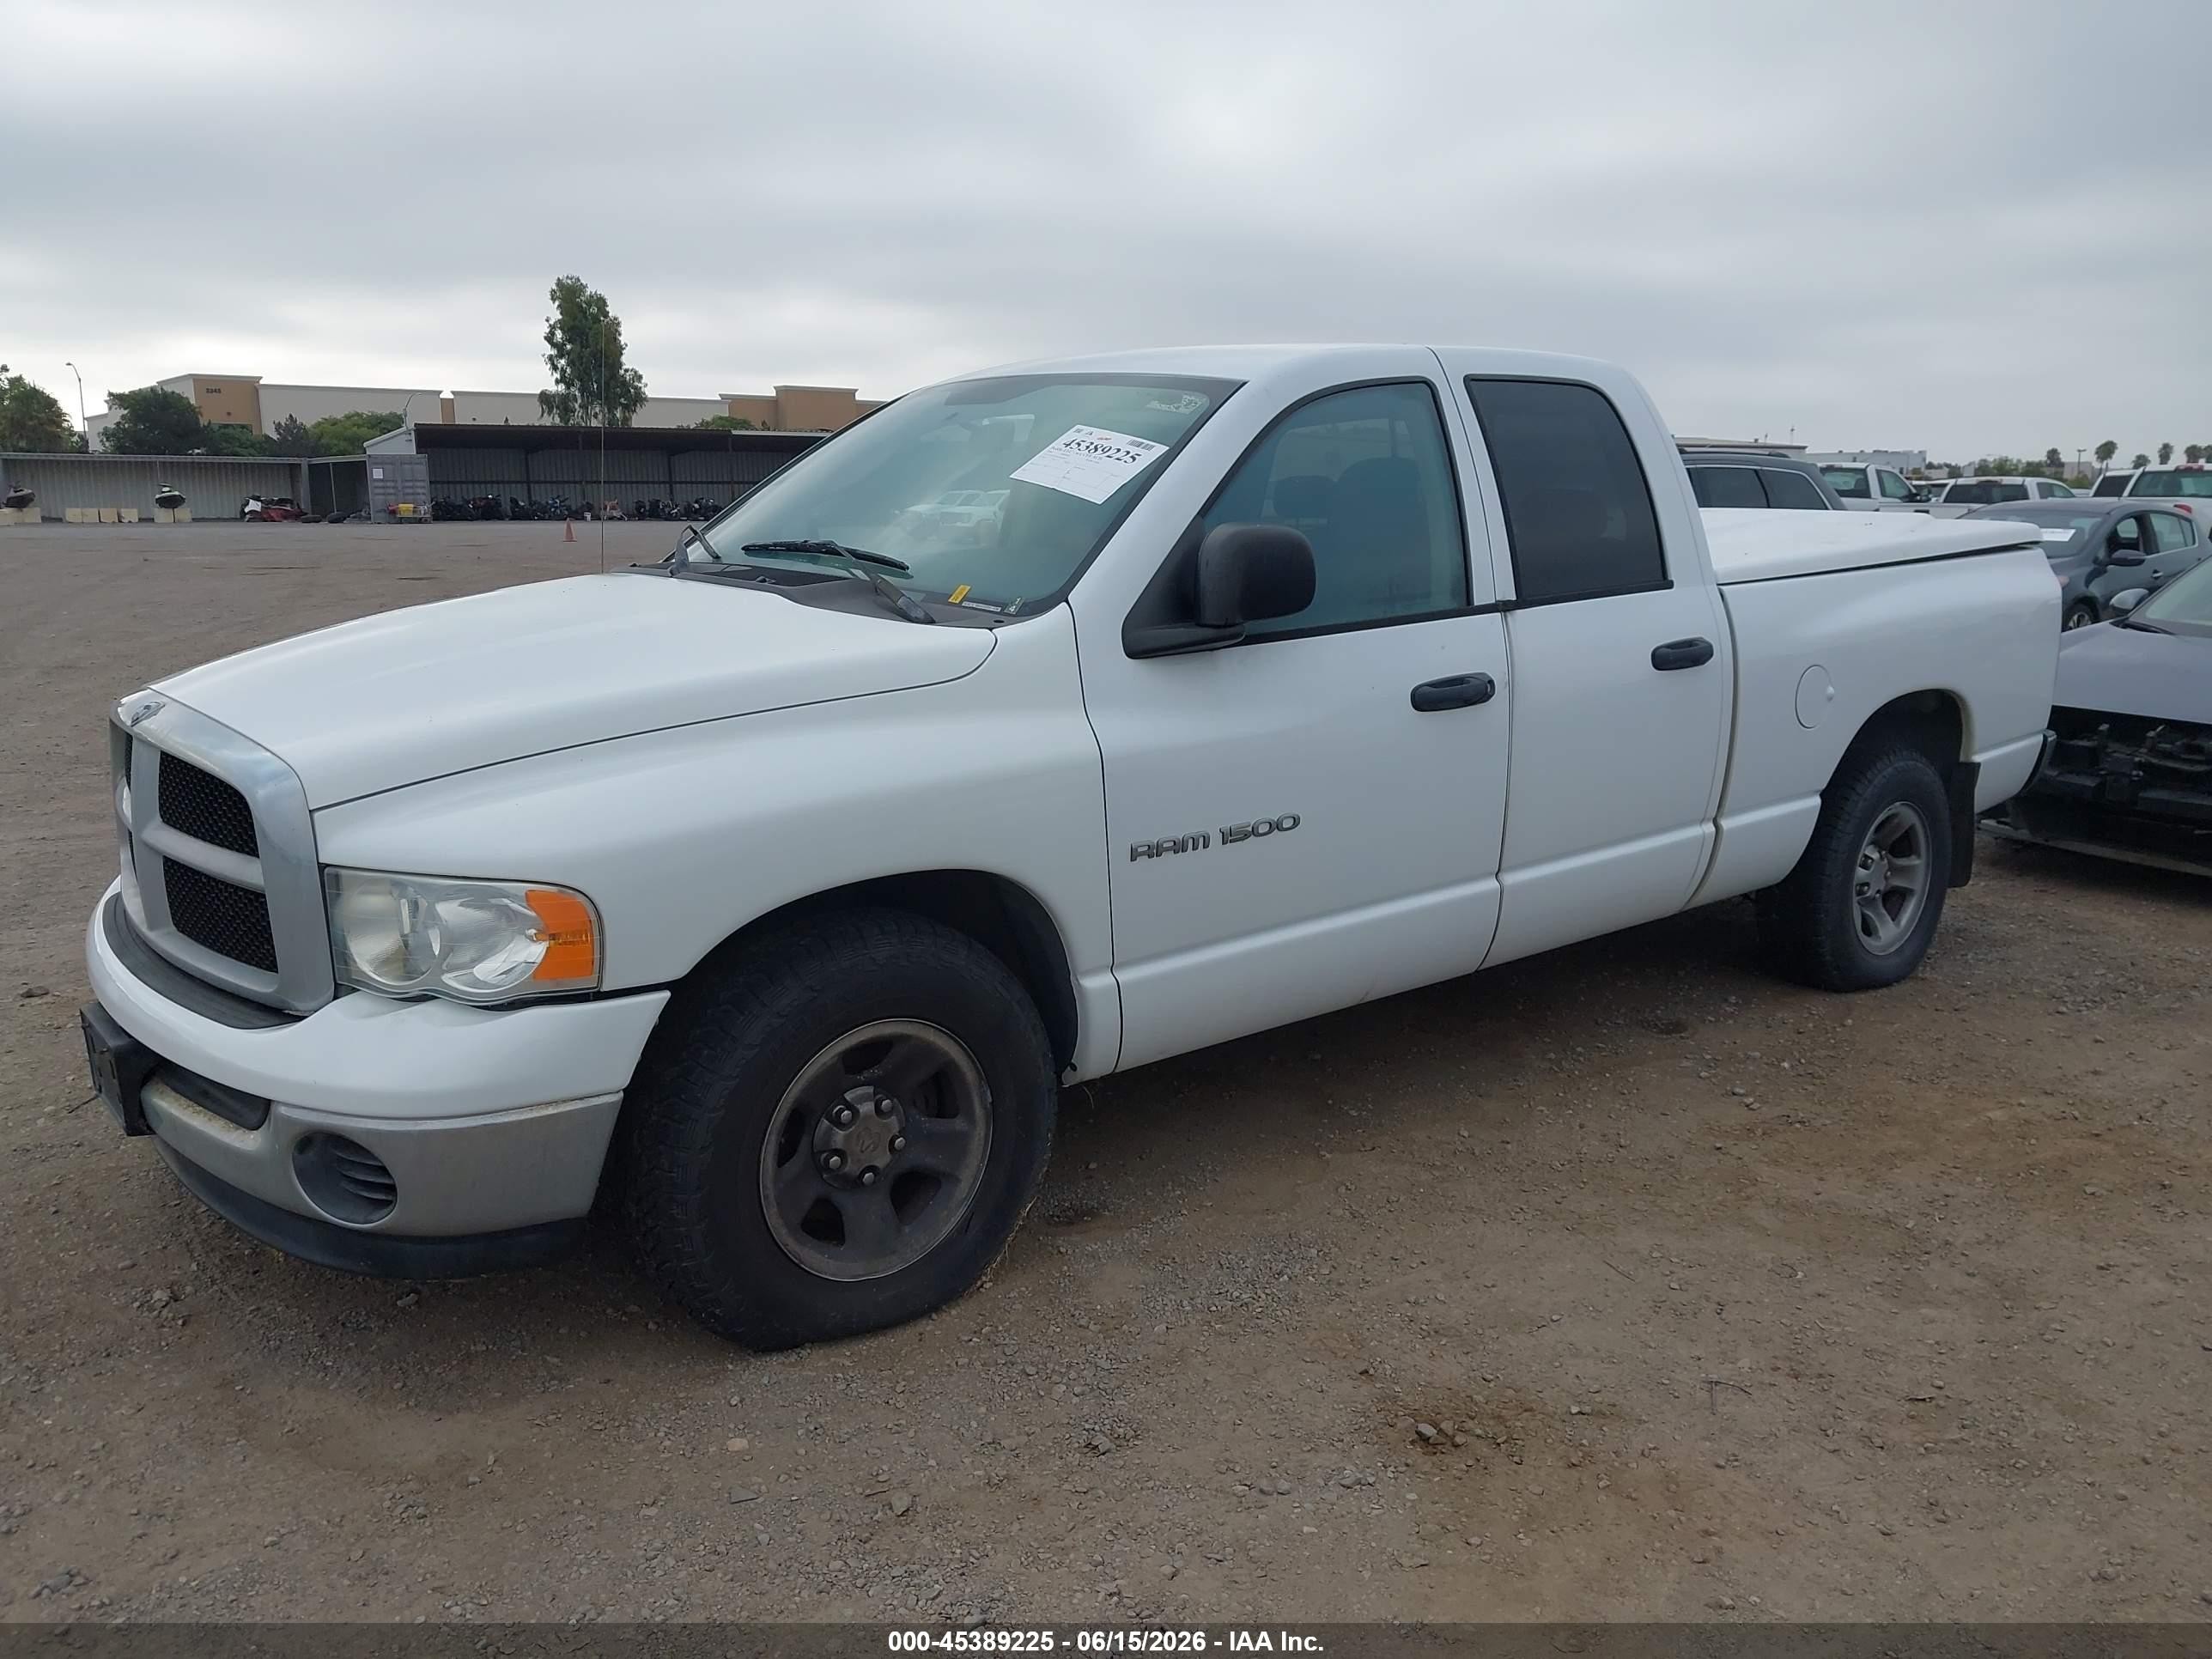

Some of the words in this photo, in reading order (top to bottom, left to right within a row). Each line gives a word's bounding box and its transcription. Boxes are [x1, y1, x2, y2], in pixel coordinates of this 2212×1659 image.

[1062, 438, 1143, 465] 45389225
[1130, 830, 1211, 862] RAM
[1218, 812, 1301, 846] 1500
